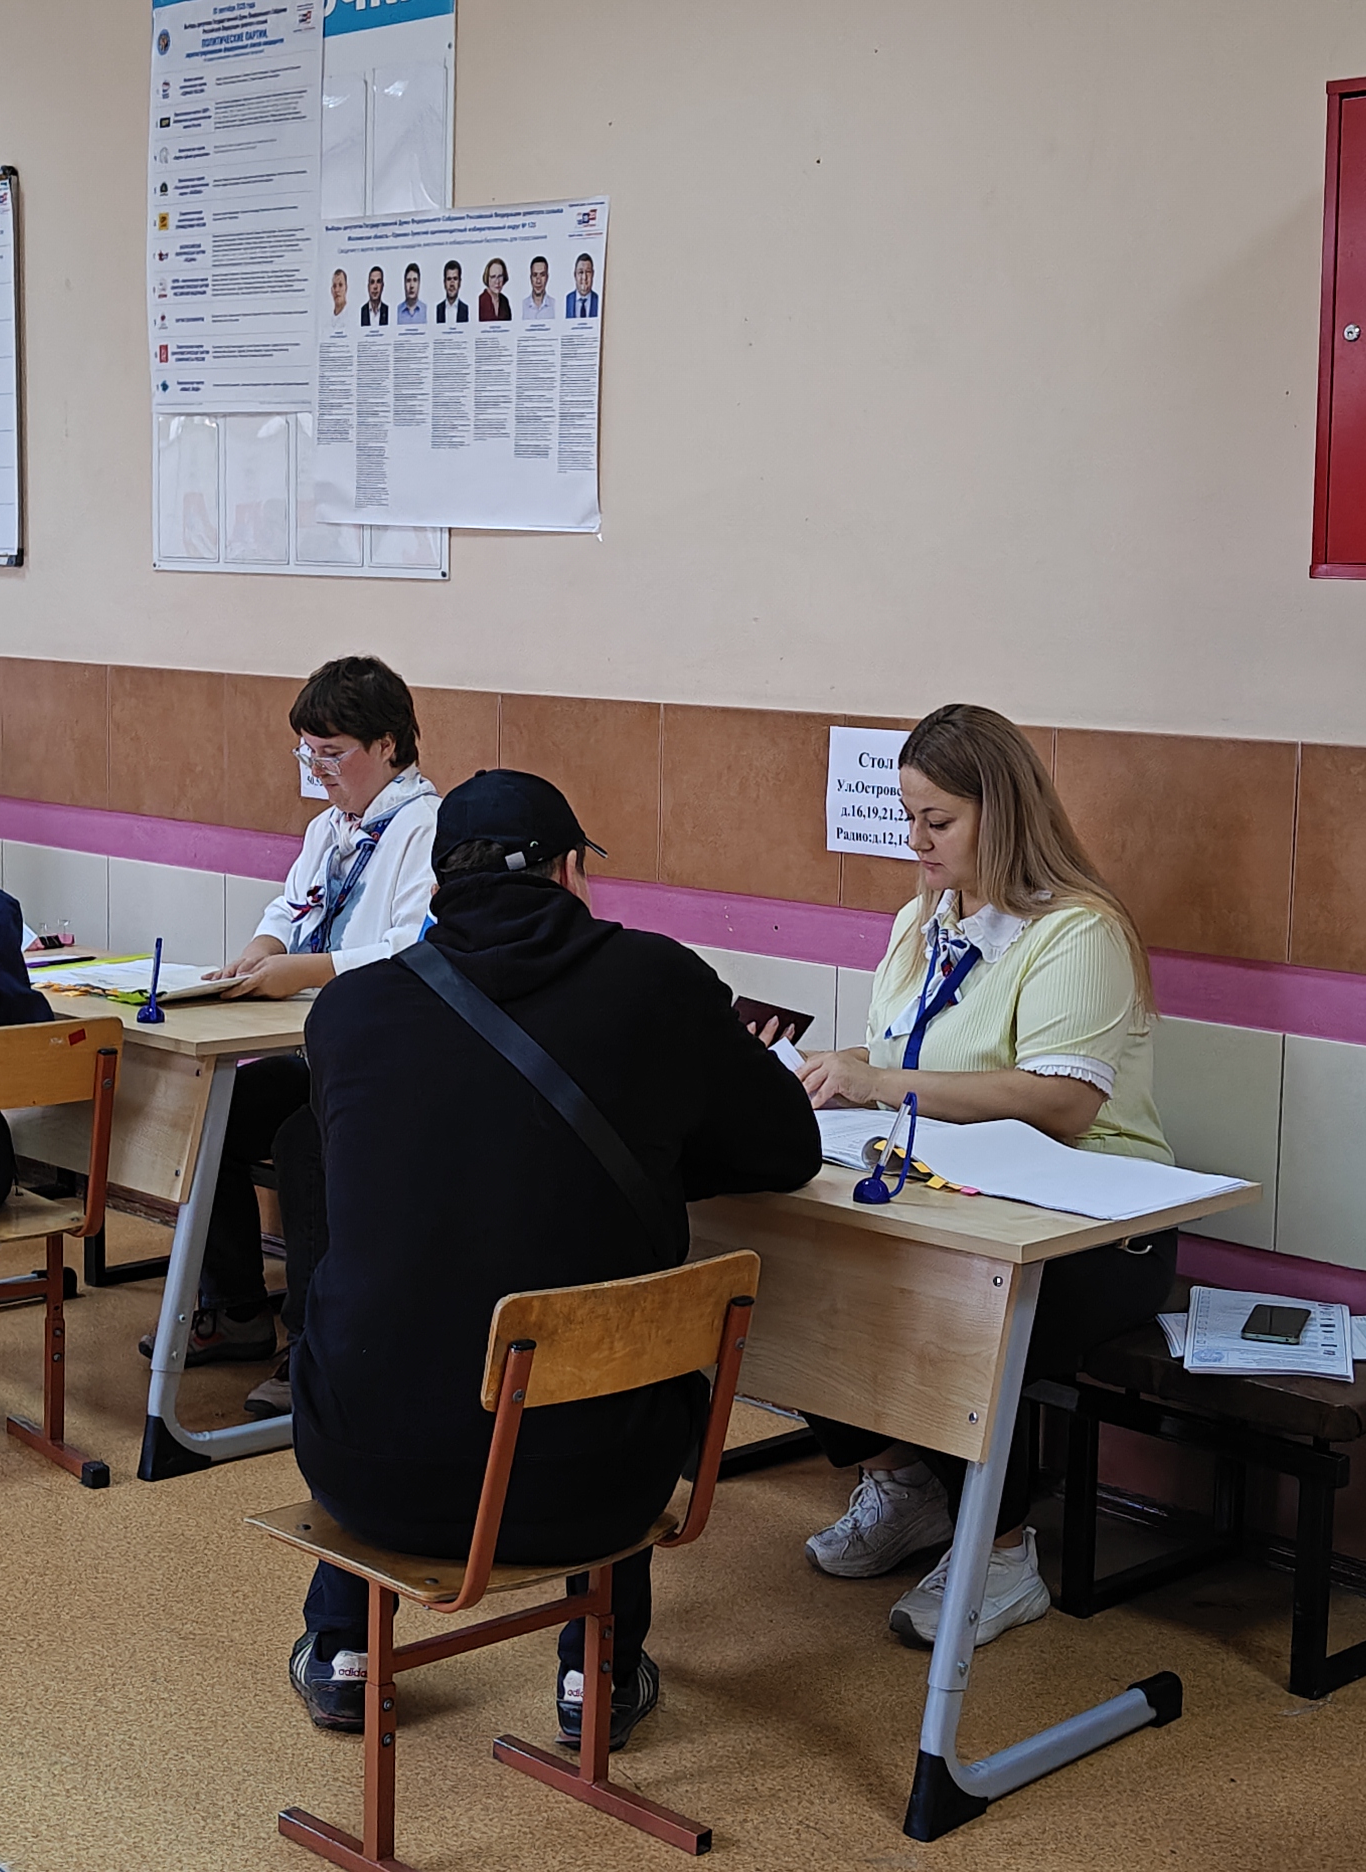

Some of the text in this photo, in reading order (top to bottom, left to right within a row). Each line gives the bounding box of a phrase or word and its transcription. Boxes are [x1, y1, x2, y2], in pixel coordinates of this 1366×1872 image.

[858, 752, 893, 770] Стол
[837, 779, 902, 799] Ул.Островс
[840, 805, 910, 822] д.16,19,21,2
[339, 1668, 368, 1677] adida
